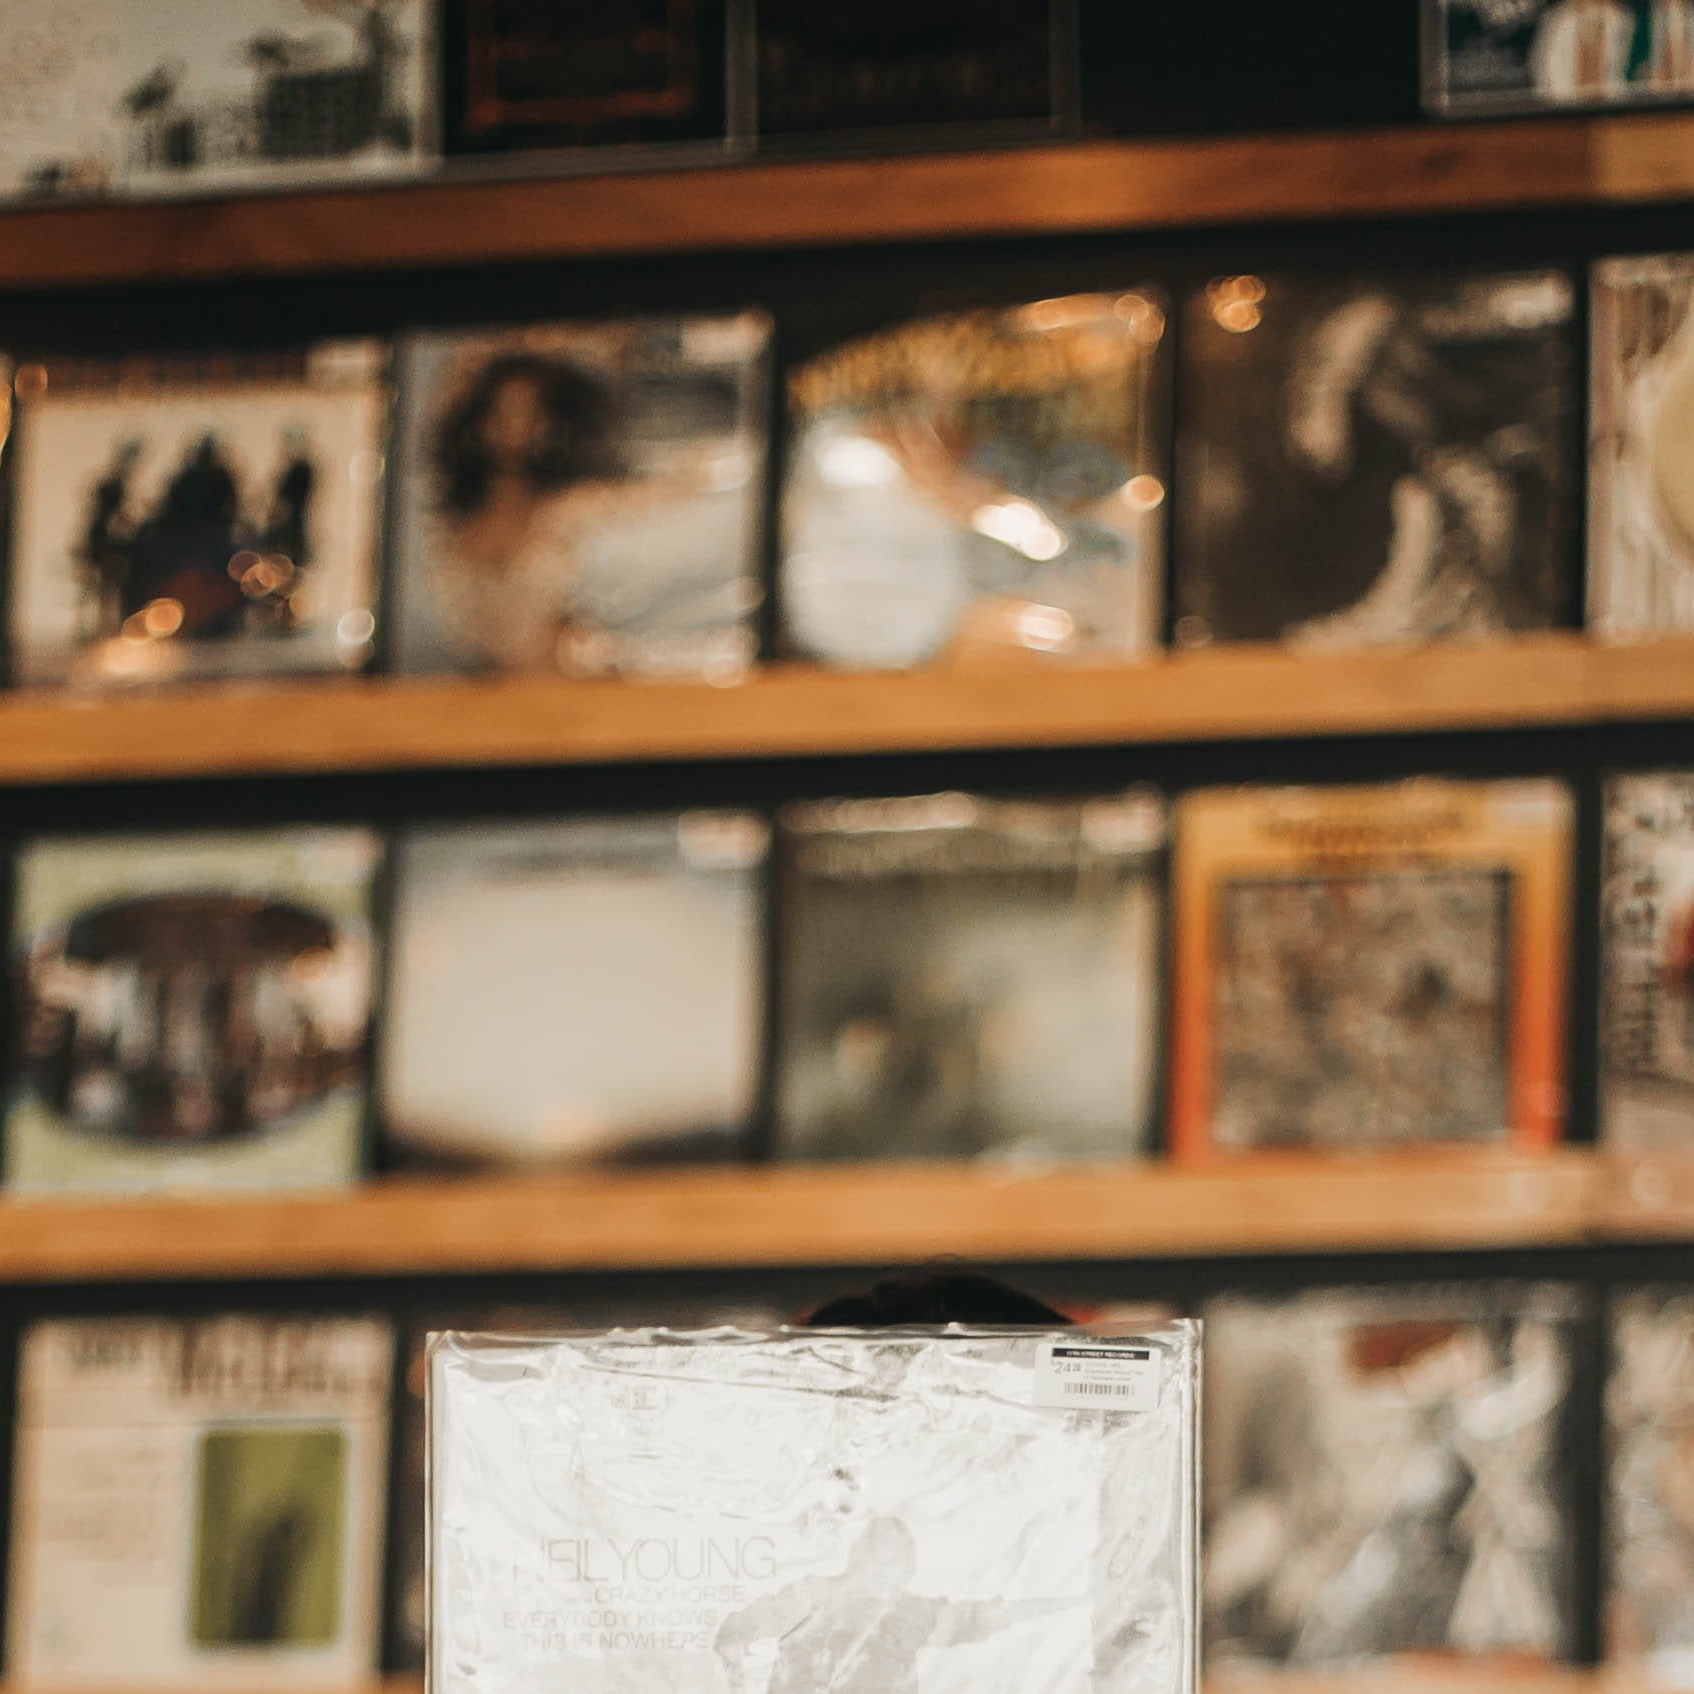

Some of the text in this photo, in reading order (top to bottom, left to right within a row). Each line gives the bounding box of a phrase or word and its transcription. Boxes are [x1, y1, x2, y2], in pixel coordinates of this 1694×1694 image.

[607, 1536, 777, 1583] YOUNG
[593, 1584, 748, 1604] CRAZY HORSE
[502, 1609, 719, 1630] EVERYBODY KNOWS
[599, 1631, 709, 1651] NOWHERE
